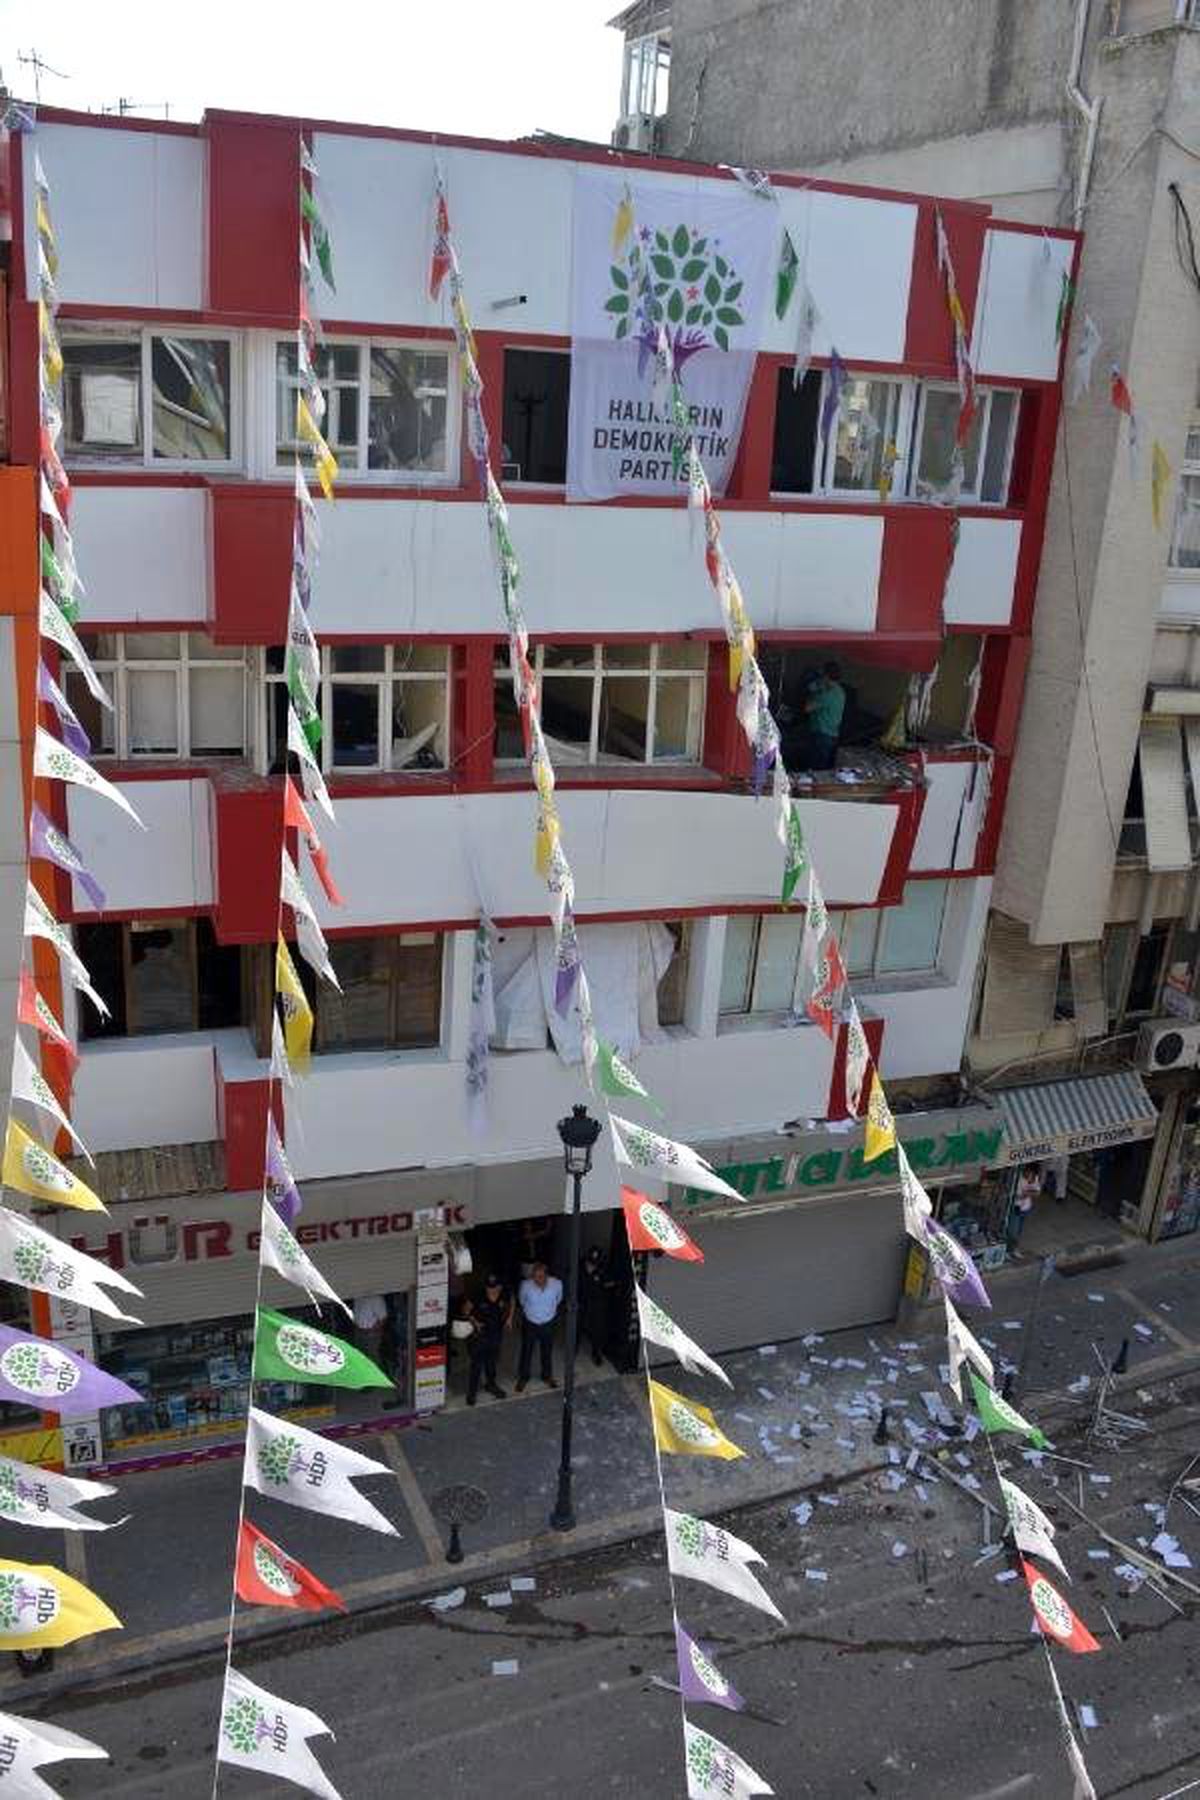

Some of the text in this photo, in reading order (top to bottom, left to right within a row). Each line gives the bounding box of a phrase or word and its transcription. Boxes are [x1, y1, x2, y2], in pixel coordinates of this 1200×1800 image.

[608, 399, 723, 428] HALKRIN
[620, 459, 691, 482] PARTS
[306, 1451, 328, 1487] HDP
[271, 1714, 288, 1753] HDP
